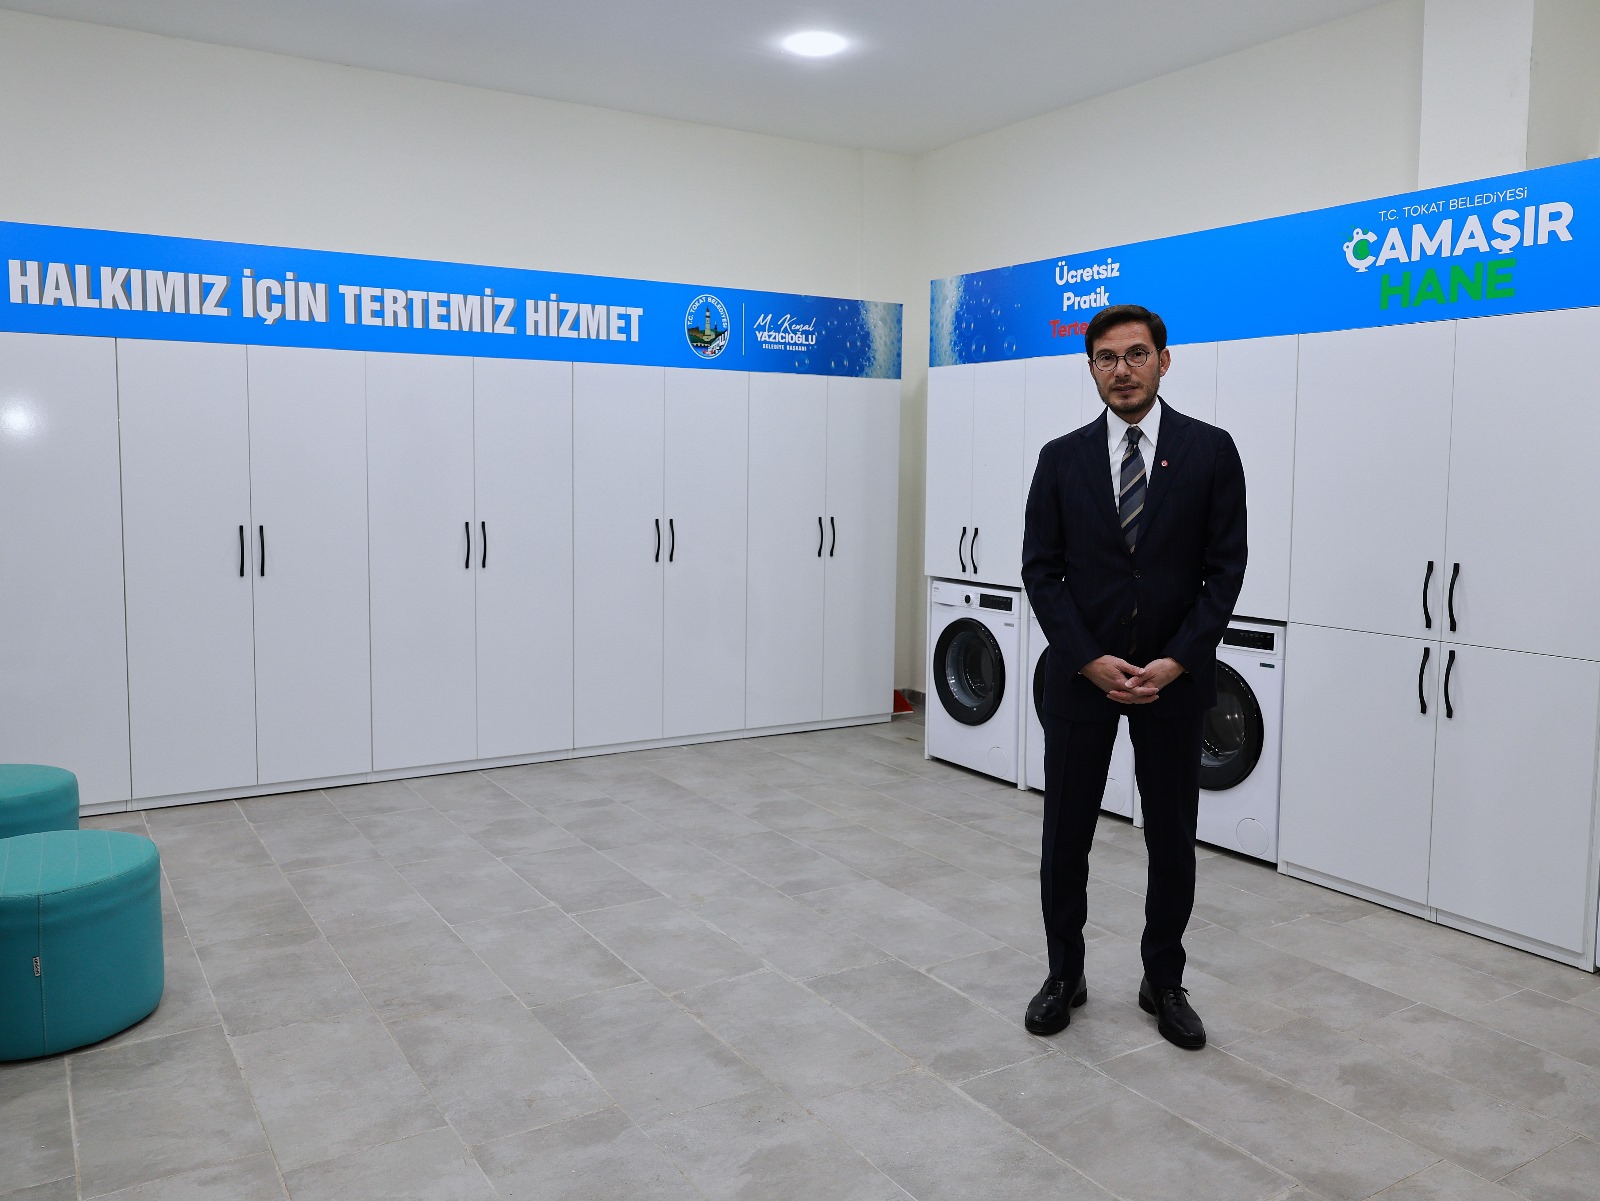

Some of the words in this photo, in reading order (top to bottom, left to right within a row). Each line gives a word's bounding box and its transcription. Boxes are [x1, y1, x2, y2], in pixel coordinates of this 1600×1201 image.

[1379, 209, 1399, 222] T.C.
[1403, 200, 1446, 218] TOKAT
[1343, 201, 1574, 273] ÇAMAŞIR
[1056, 258, 1120, 286] Ücretsiz
[1379, 258, 1517, 311] HANE
[8, 259, 230, 316] HALKIMIZ
[242, 268, 329, 325] İÇİN
[338, 284, 517, 335] TERTEMİZ
[526, 293, 644, 342] HİZMET
[690, 296, 706, 313] TOKAT
[1062, 286, 1110, 312] Pratik
[778, 314, 816, 333] Kemal
[755, 331, 816, 344] YAZICIOĞLU
